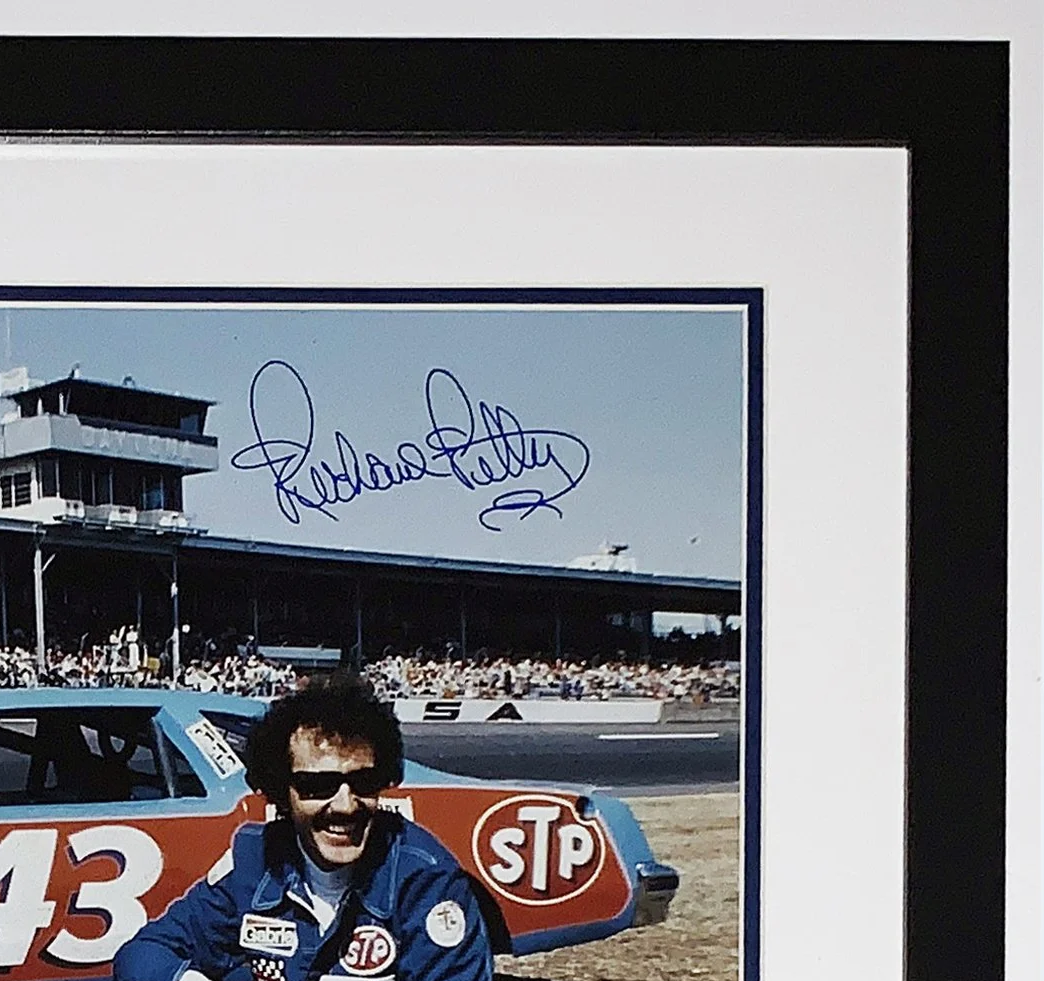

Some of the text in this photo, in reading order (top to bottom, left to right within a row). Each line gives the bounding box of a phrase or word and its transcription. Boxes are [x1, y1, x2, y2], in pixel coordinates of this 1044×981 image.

[425, 367, 591, 532] Petty
[488, 805, 596, 892] STP
[345, 932, 390, 967] STP
